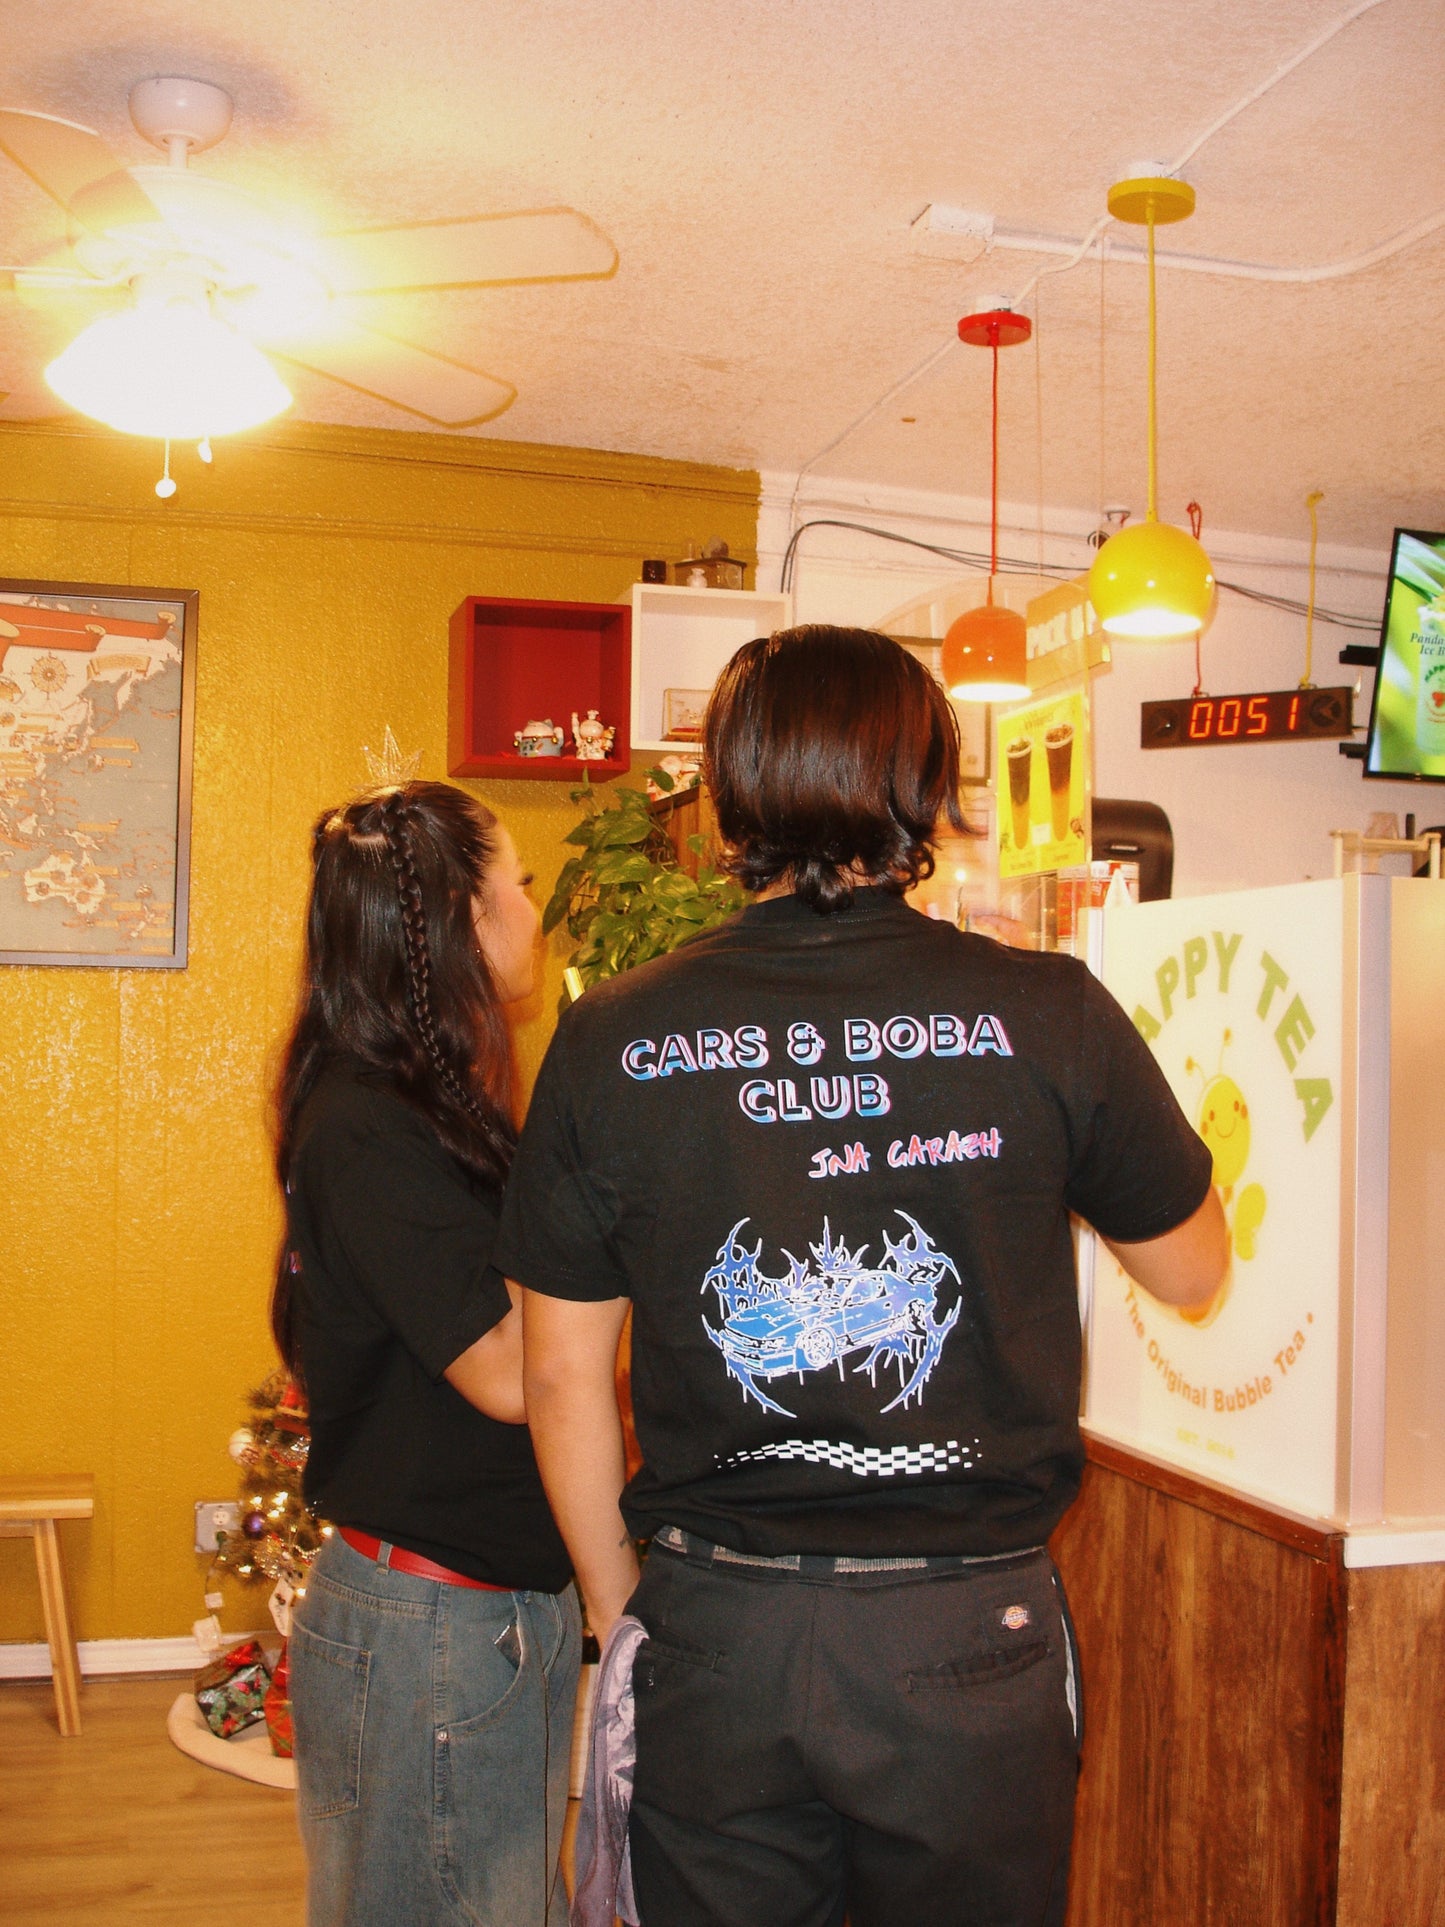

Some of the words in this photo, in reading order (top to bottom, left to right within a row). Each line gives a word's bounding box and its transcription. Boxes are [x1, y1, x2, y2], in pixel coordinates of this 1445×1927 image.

[621, 1025, 769, 1081] CARS
[787, 1021, 826, 1066] &
[844, 1013, 1014, 1063] BOBA
[1131, 930, 1243, 1044] APPY
[1256, 949, 1334, 1144] TEA
[738, 1073, 892, 1124] CLUB
[808, 1141, 871, 1179] JNA
[1147, 1338, 1207, 1410] Original
[1213, 1374, 1273, 1414] Bubble
[1273, 1328, 1306, 1376] Tea
